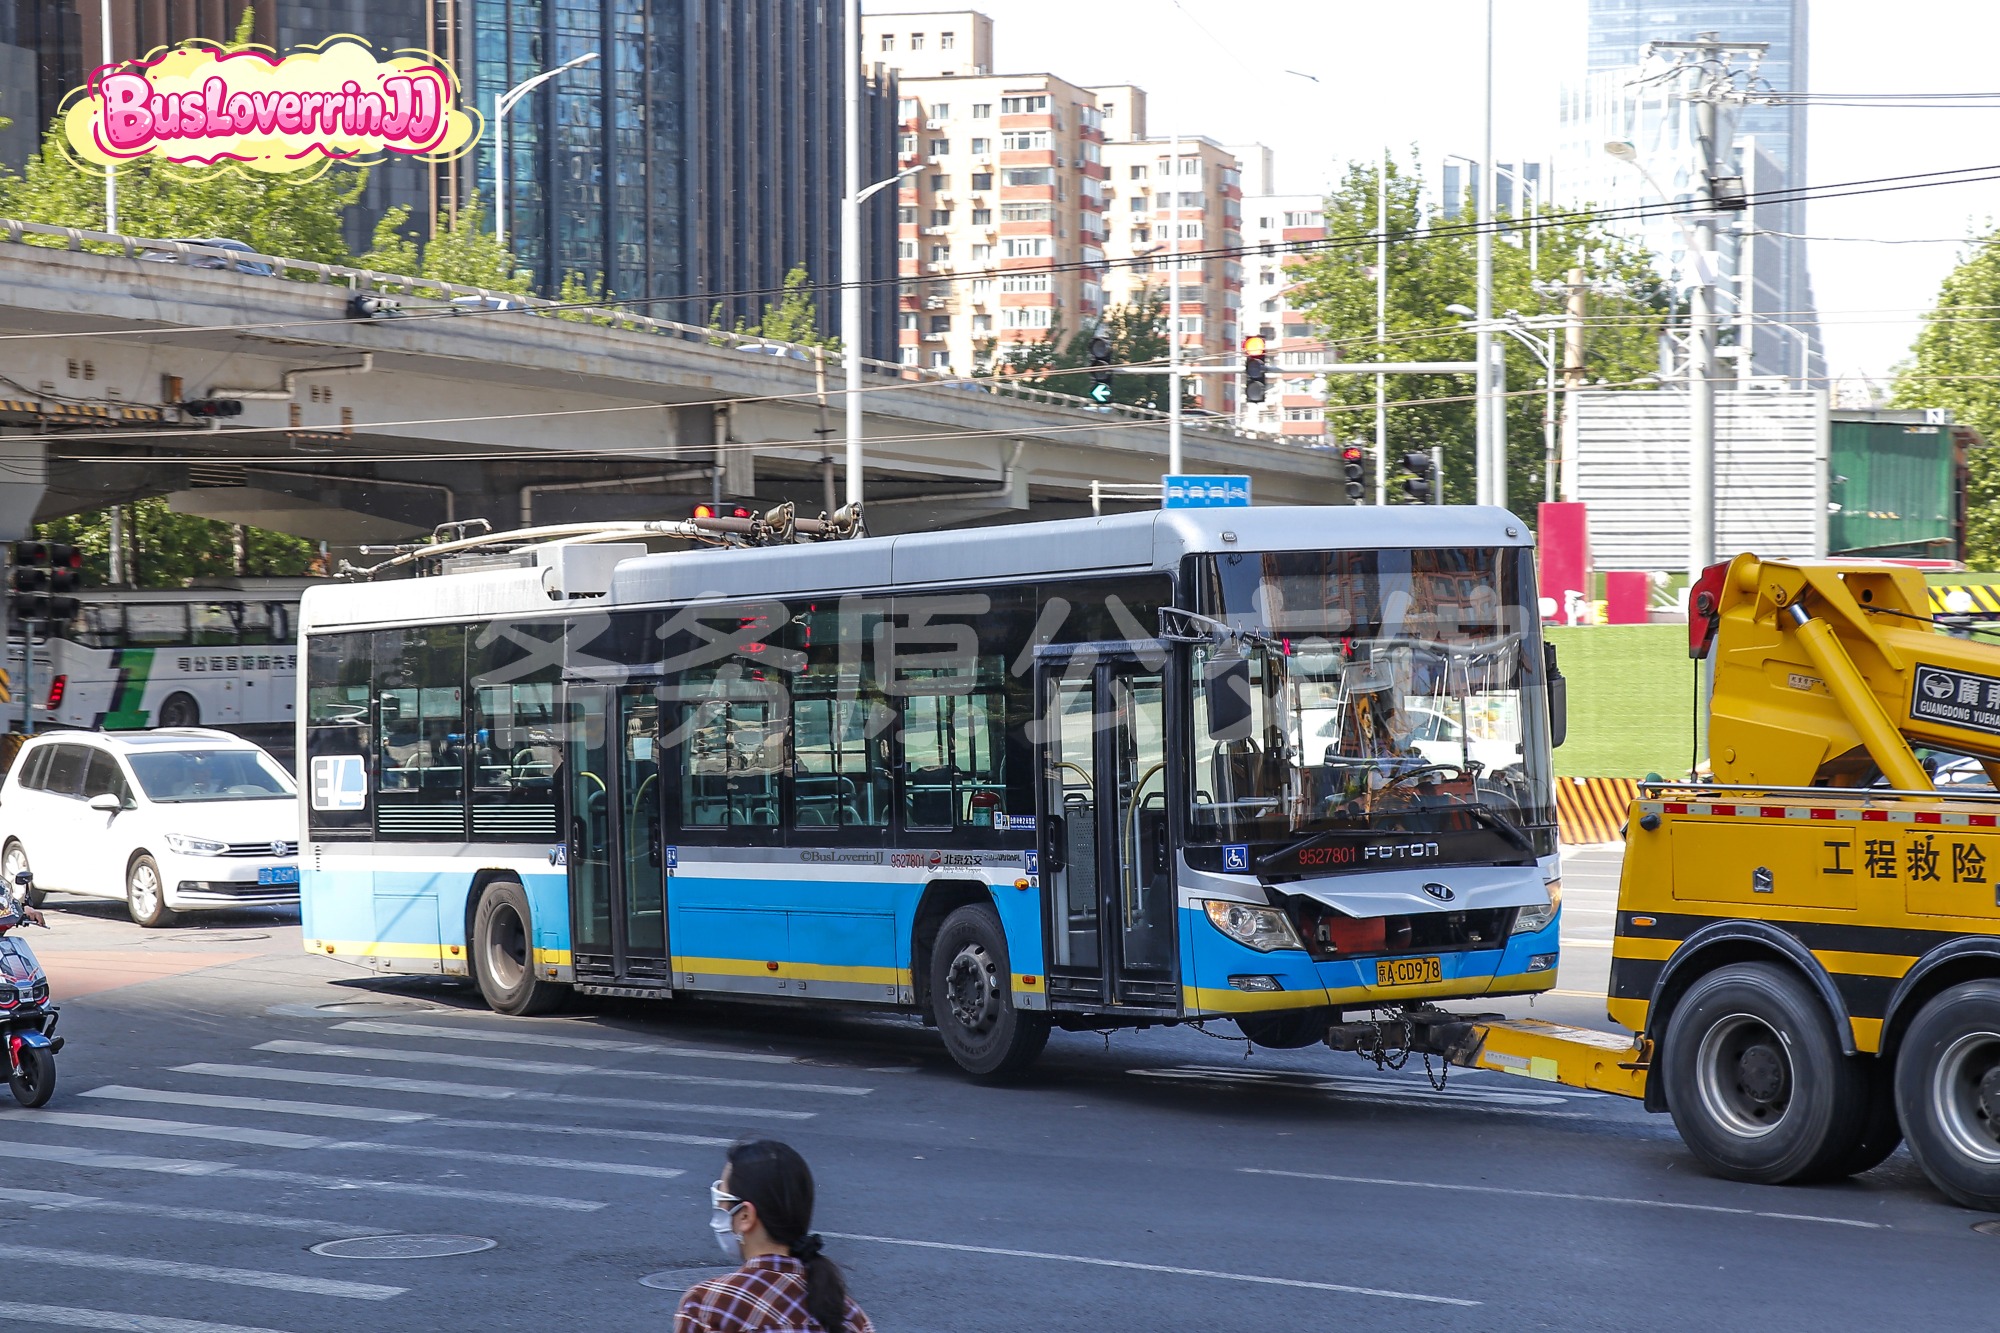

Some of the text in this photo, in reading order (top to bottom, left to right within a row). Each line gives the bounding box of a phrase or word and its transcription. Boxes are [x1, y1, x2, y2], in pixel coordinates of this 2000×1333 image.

[1920, 700, 1971, 720] GUANGDONG
[890, 853, 926, 869] 9527801
[943, 853, 983, 866] 北京公交
[1298, 842, 1439, 865] 9527801 FOTON
[1822, 834, 1987, 884] 工程救险
